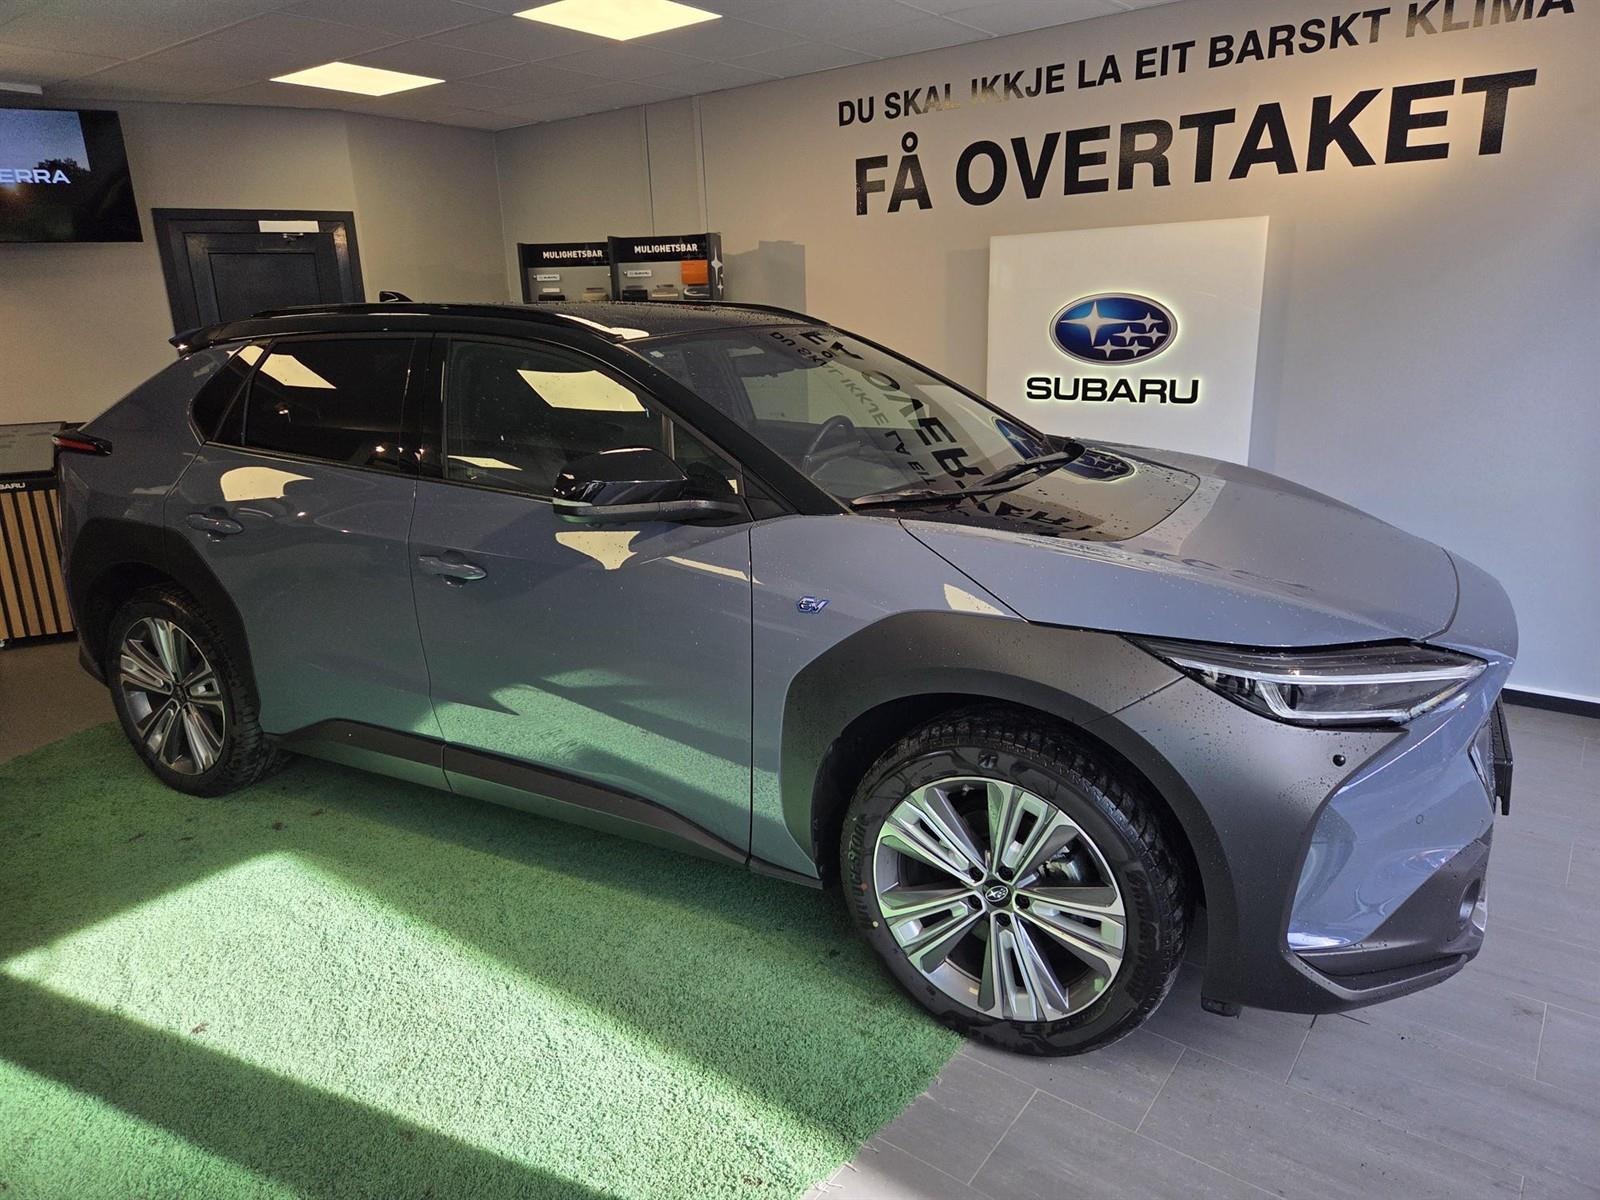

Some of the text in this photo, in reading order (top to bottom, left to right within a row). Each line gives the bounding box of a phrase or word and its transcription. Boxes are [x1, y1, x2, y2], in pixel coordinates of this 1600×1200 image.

[838, 96, 875, 126] DU
[884, 83, 959, 119] SKAL
[970, 63, 1065, 103] IKKJE
[1078, 54, 1122, 89] LA
[1135, 40, 1196, 80] EIT
[1208, 7, 1391, 68] BARSKT
[855, 69, 1537, 215] FÅ OVERTAKET
[0, 169, 71, 184] ERRA
[542, 249, 603, 259] MULIGHETSBAR
[634, 243, 698, 254] MULIGHETSBAR
[1026, 376, 1199, 404] SUBARU
